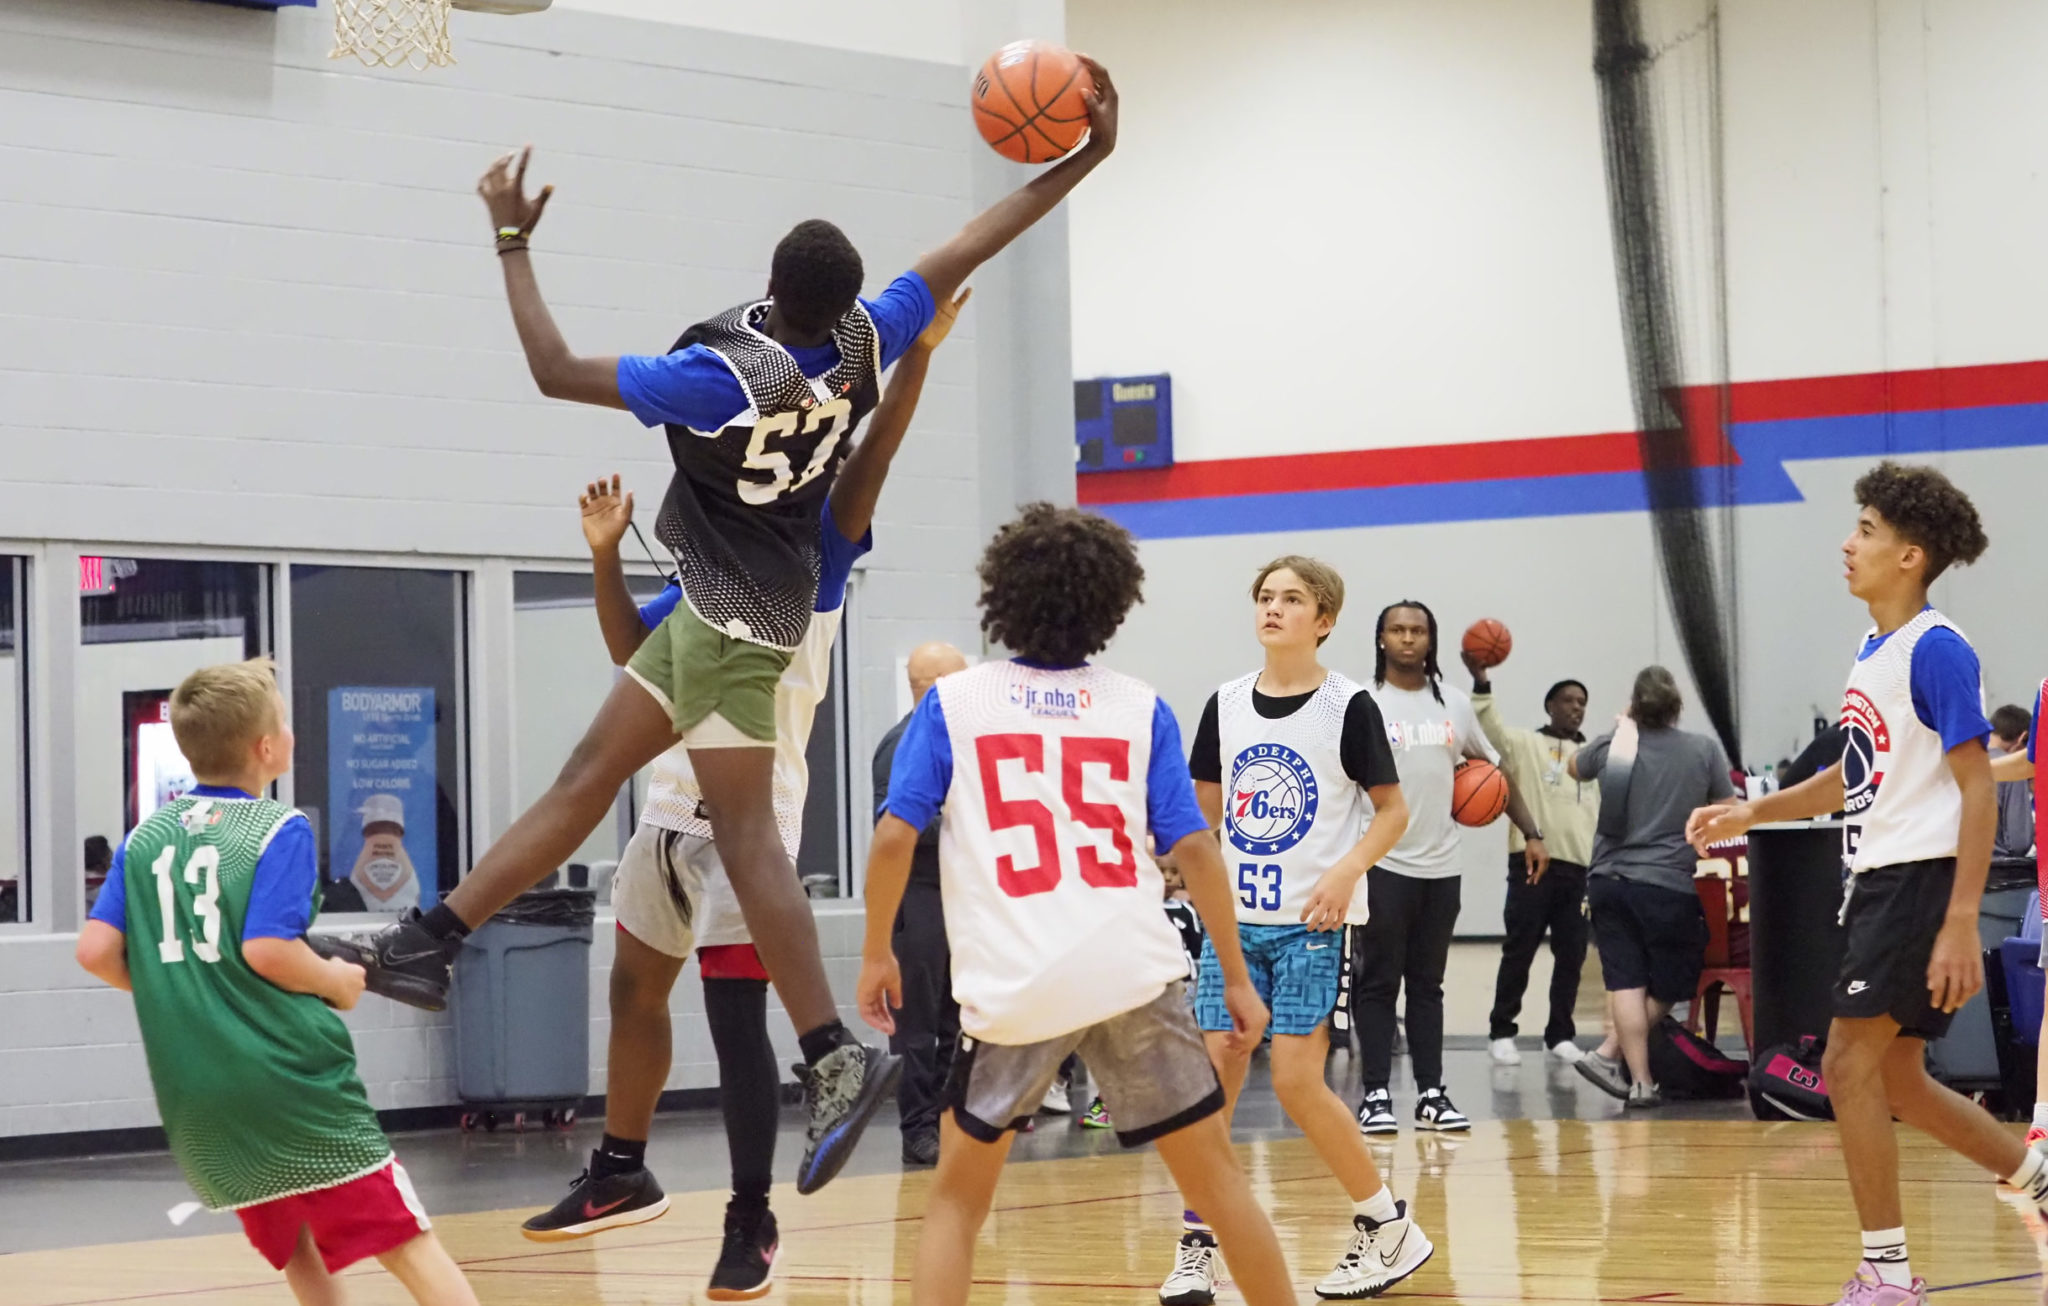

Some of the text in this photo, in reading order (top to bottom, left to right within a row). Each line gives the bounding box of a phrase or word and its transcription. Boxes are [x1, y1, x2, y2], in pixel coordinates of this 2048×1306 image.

[737, 398, 852, 505] 57
[342, 692, 421, 711] BODYARMOR
[975, 733, 1138, 898] 55
[1235, 789, 1296, 820] 76ers
[152, 845, 221, 963] 13
[1238, 863, 1283, 911] 53
